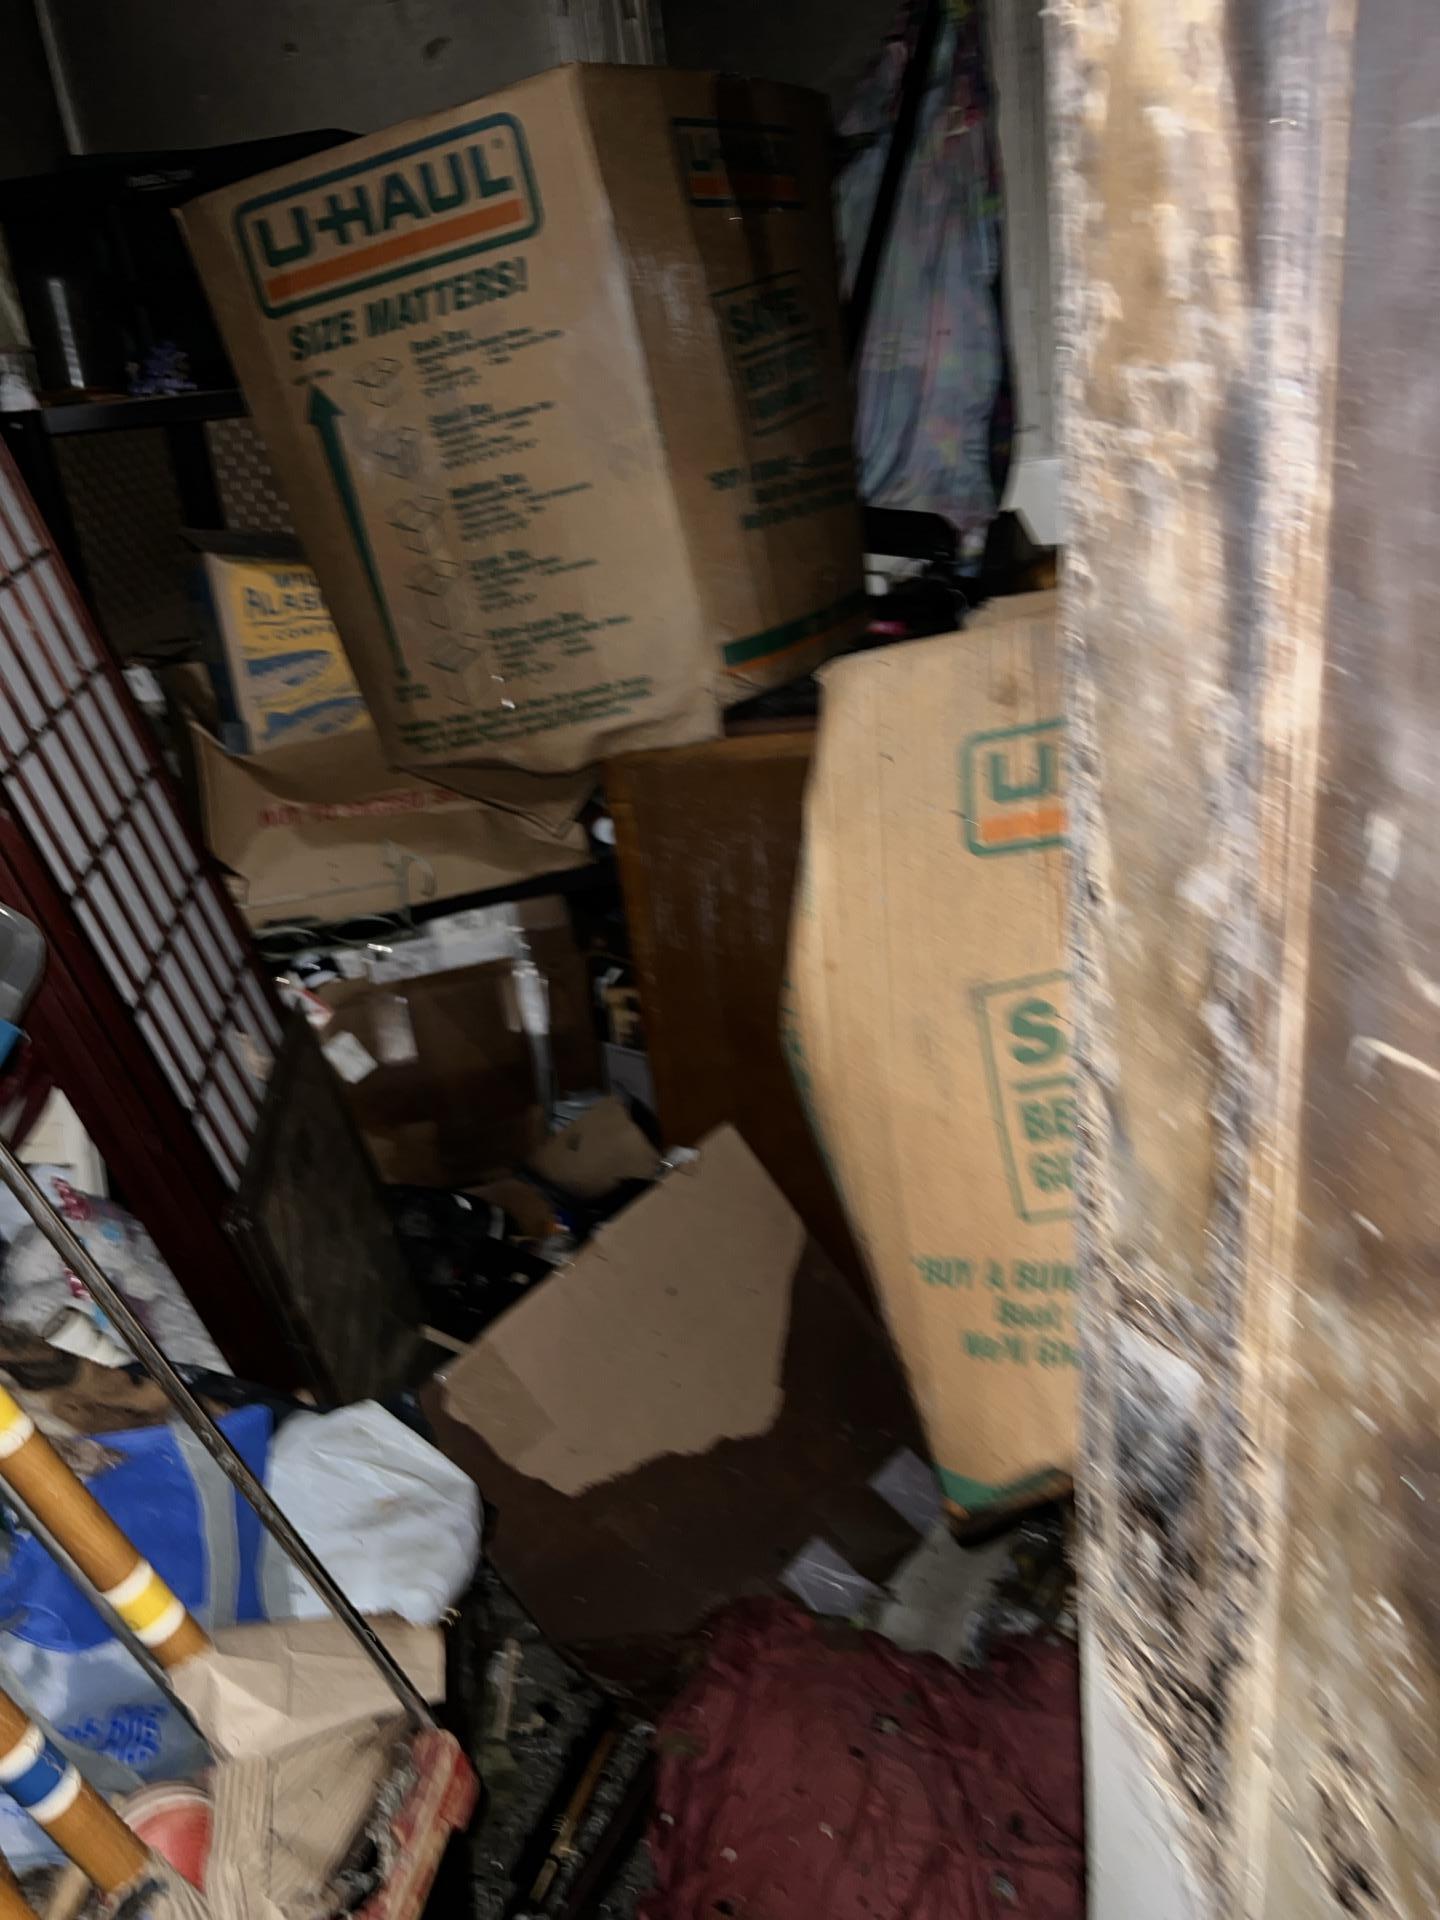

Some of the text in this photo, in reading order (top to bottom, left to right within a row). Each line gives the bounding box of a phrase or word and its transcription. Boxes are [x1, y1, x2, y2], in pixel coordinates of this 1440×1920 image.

[253, 143, 515, 268] U-HAUL
[288, 255, 529, 362] SIZE MATTERS!
